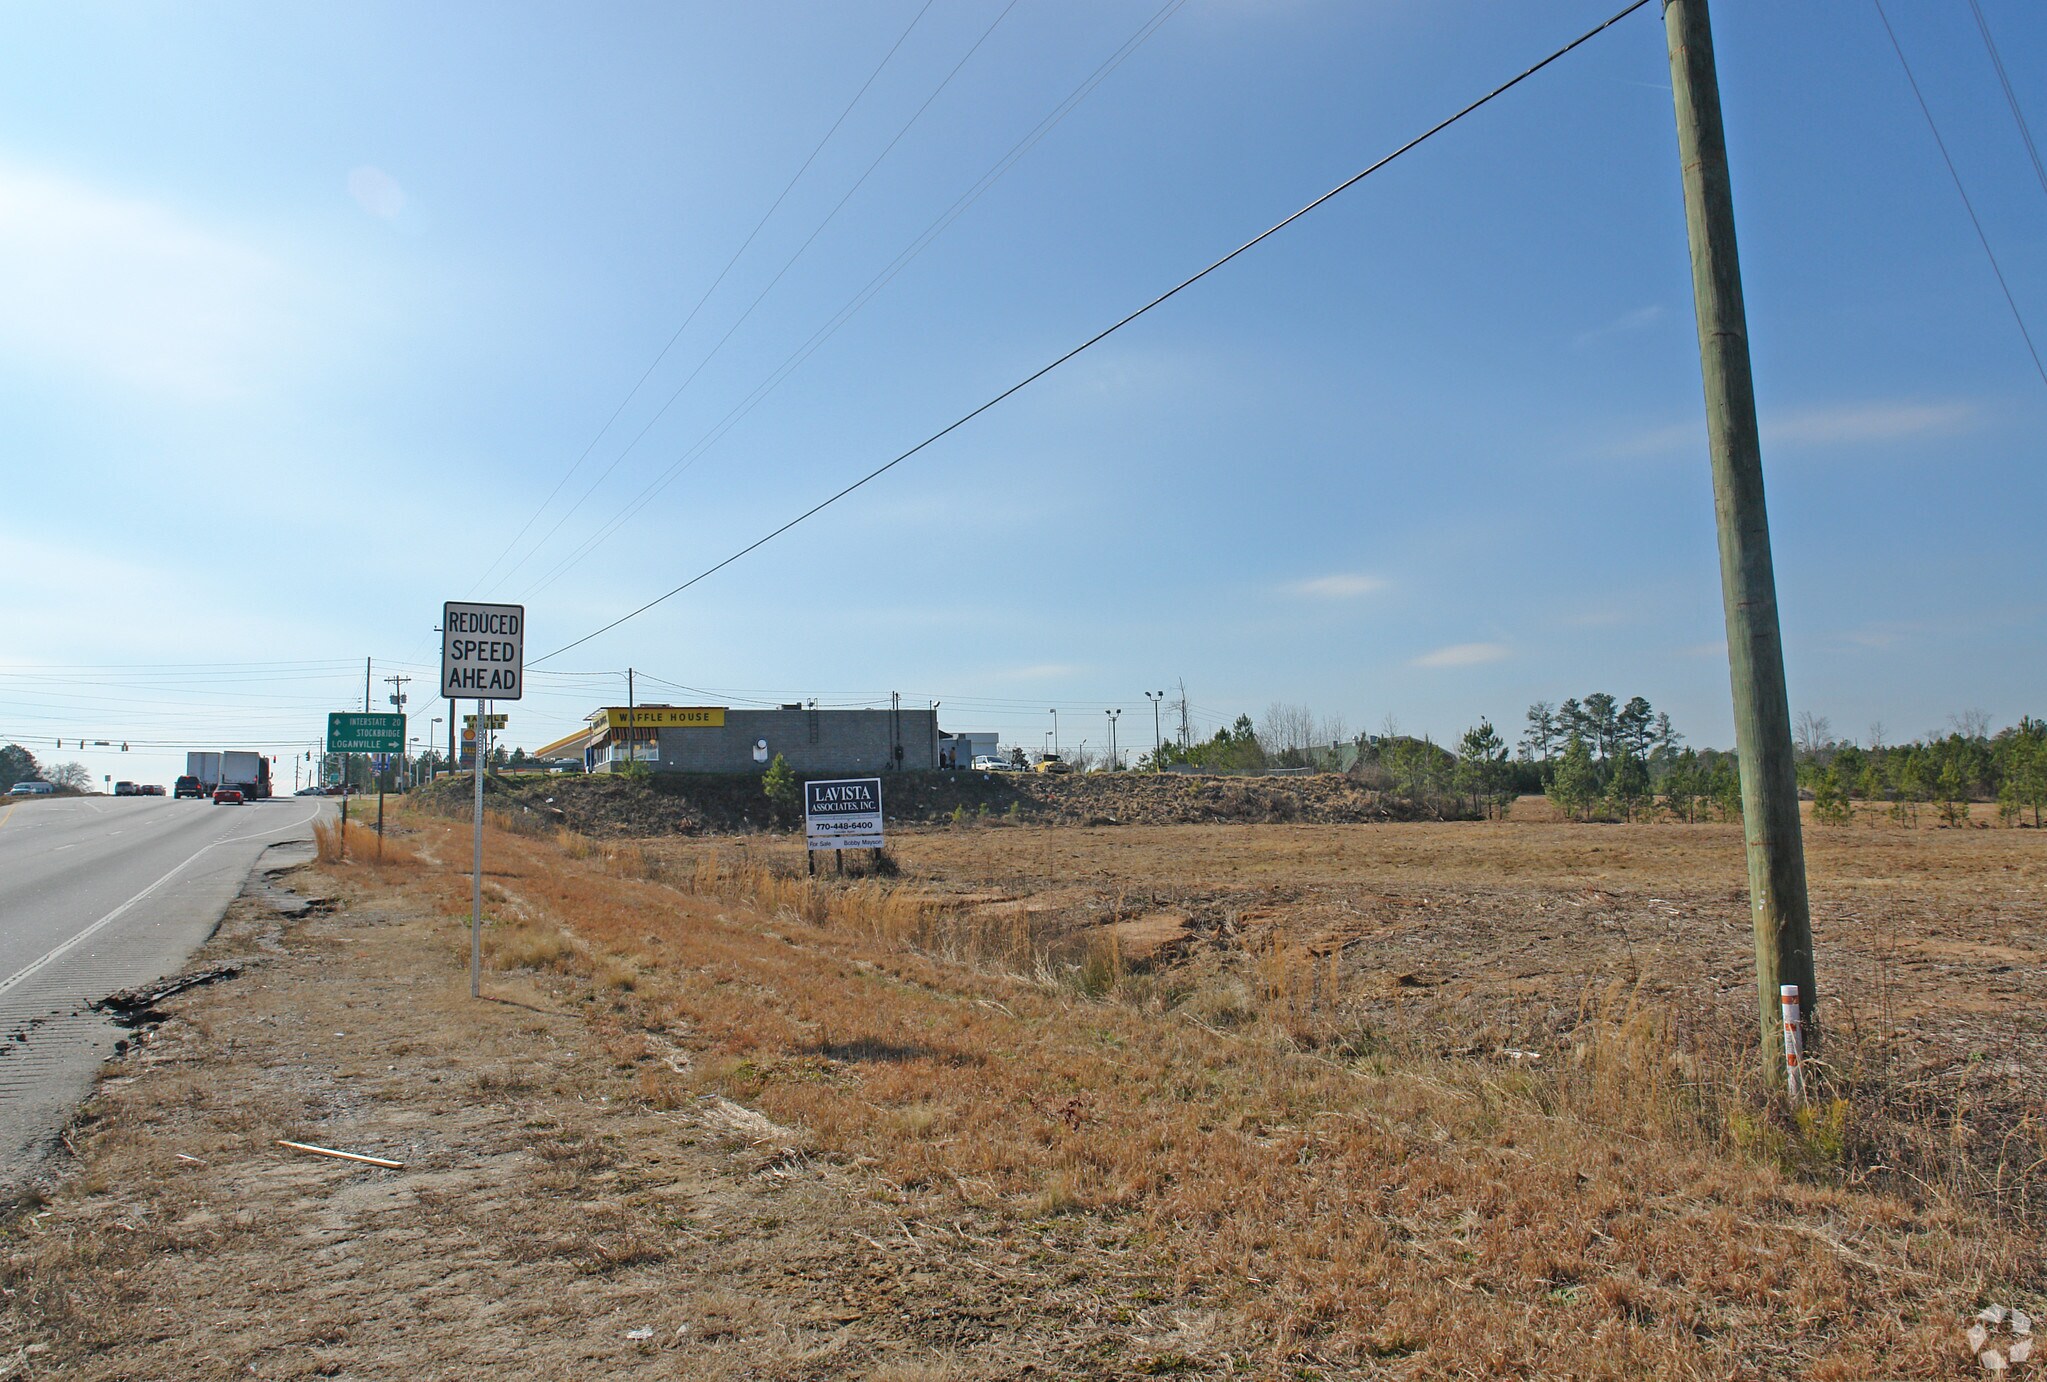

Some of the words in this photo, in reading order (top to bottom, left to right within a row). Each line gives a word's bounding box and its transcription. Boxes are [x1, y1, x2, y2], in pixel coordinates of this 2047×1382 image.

[449, 612, 518, 635] REDUCED
[451, 640, 514, 662] SPEED
[448, 668, 515, 689] AHEAD
[464, 714, 507, 722] WAFLE
[670, 713, 709, 721] HOUSE
[349, 718, 386, 726] INTERSTATE
[392, 718, 401, 726] 20
[356, 729, 401, 737] STOCKBRIDGE
[331, 740, 381, 748] LOGANVILLE
[815, 786, 871, 801] LAVISTA
[860, 801, 876, 810] INC.
[816, 822, 873, 830] 770-448-6400
